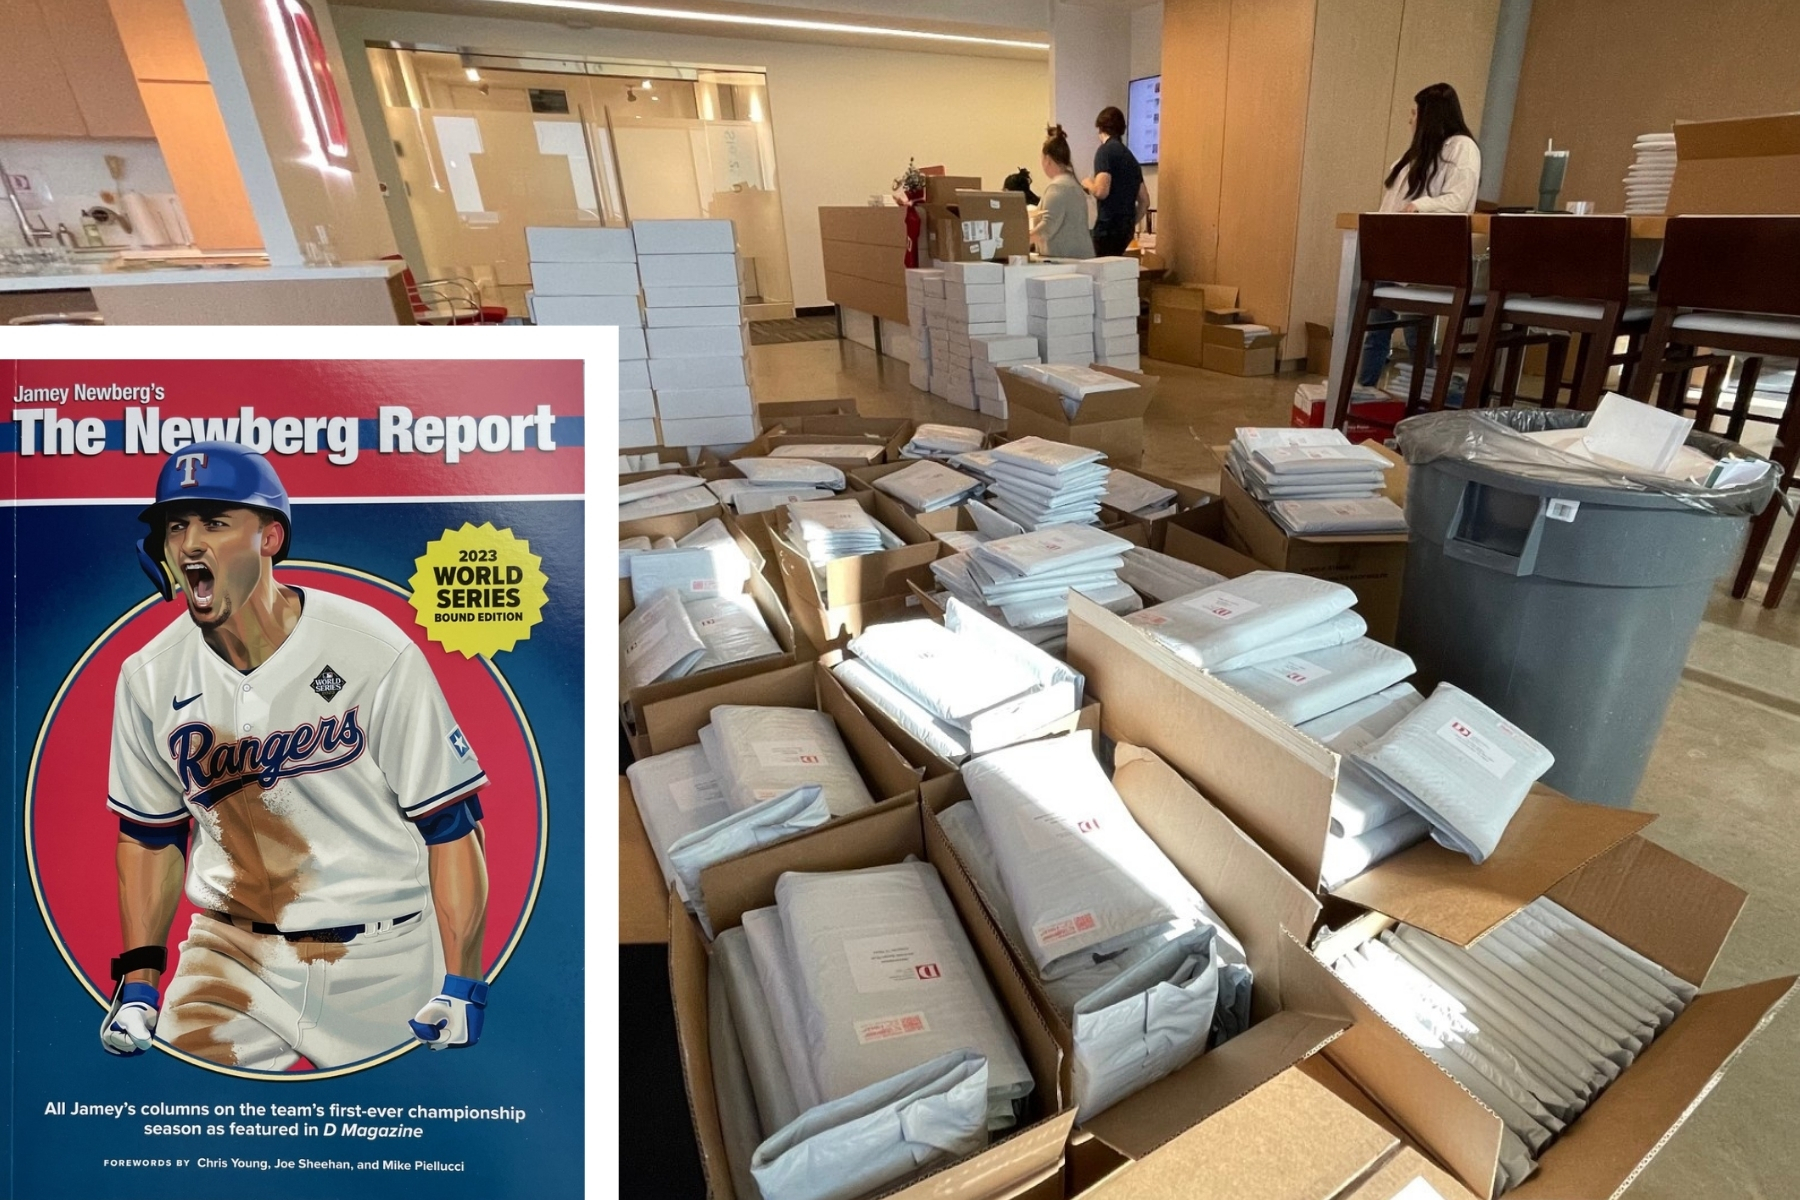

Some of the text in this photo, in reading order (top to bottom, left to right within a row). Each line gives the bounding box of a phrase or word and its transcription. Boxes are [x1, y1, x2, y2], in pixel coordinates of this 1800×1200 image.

[13, 386, 69, 405] Jamey
[12, 404, 556, 465] The Newberg Report
[175, 453, 208, 488] T
[458, 549, 498, 562] 2023
[433, 566, 524, 586] WORLD
[436, 588, 521, 609] SERIES
[434, 612, 523, 622] BOUND EDITION
[315, 677, 341, 686] WORLD
[315, 684, 342, 692] SERIES
[168, 704, 366, 797] Rangers
[44, 1101, 66, 1116] All
[140, 1102, 209, 1116] columns
[214, 1106, 234, 1116] on
[239, 1103, 266, 1117] the
[329, 1104, 404, 1118] first-ever
[408, 1105, 526, 1123] championship
[143, 1121, 424, 1140] season as featured in D Magazine
[103, 1157, 465, 1172] FOREWORDS BY Chris Young, Joe Sheehan, and Mike Piellucci
